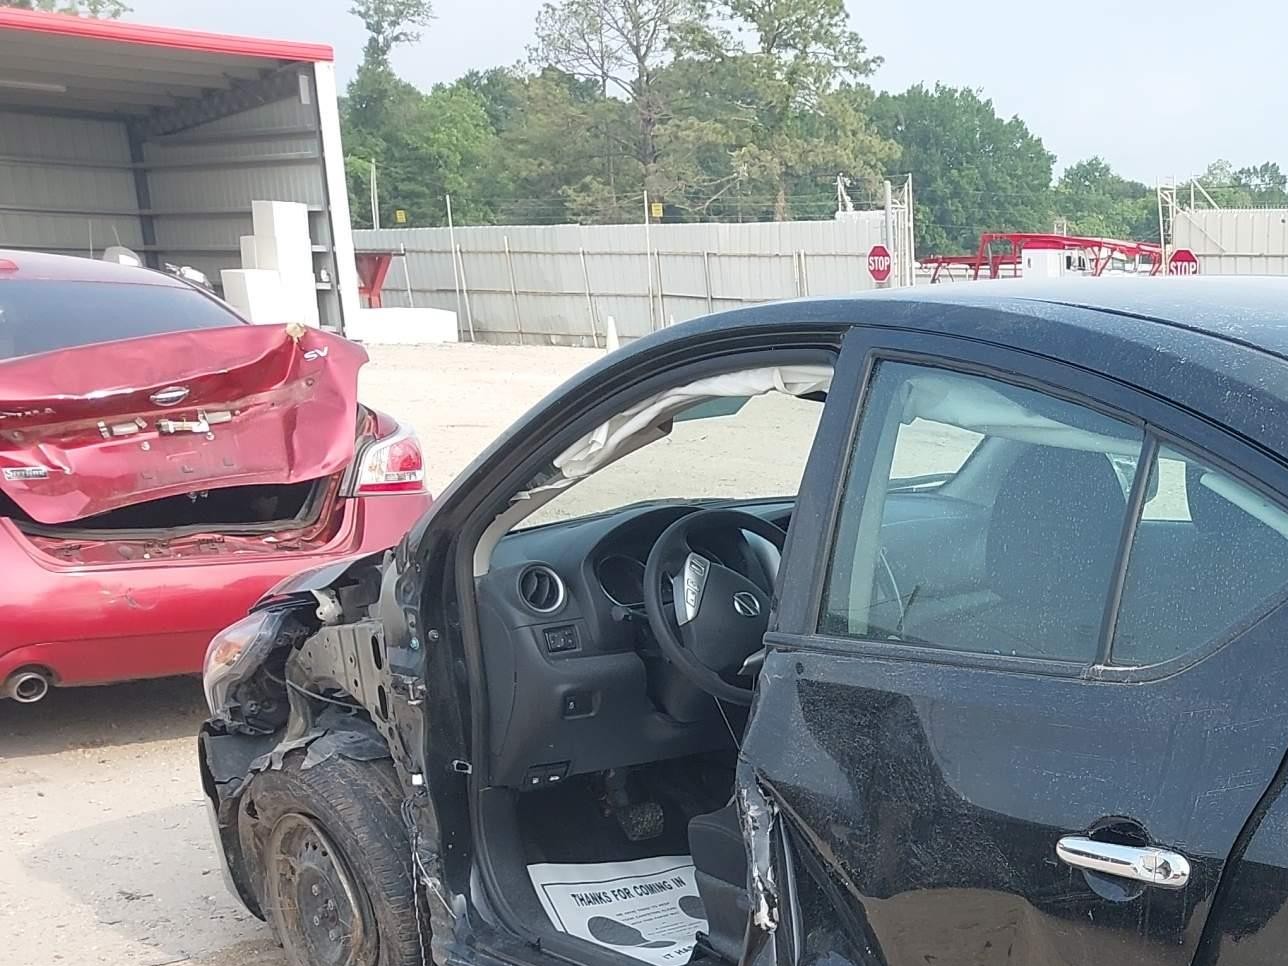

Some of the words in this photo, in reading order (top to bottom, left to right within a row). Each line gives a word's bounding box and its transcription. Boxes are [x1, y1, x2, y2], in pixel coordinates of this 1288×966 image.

[869, 256, 890, 271] STOP
[1170, 261, 1197, 276] STOP
[304, 346, 328, 361] SV
[570, 891, 613, 908] THANKS
[612, 888, 634, 901] FOR
[632, 879, 674, 897] COMING
[670, 876, 687, 889] IN
